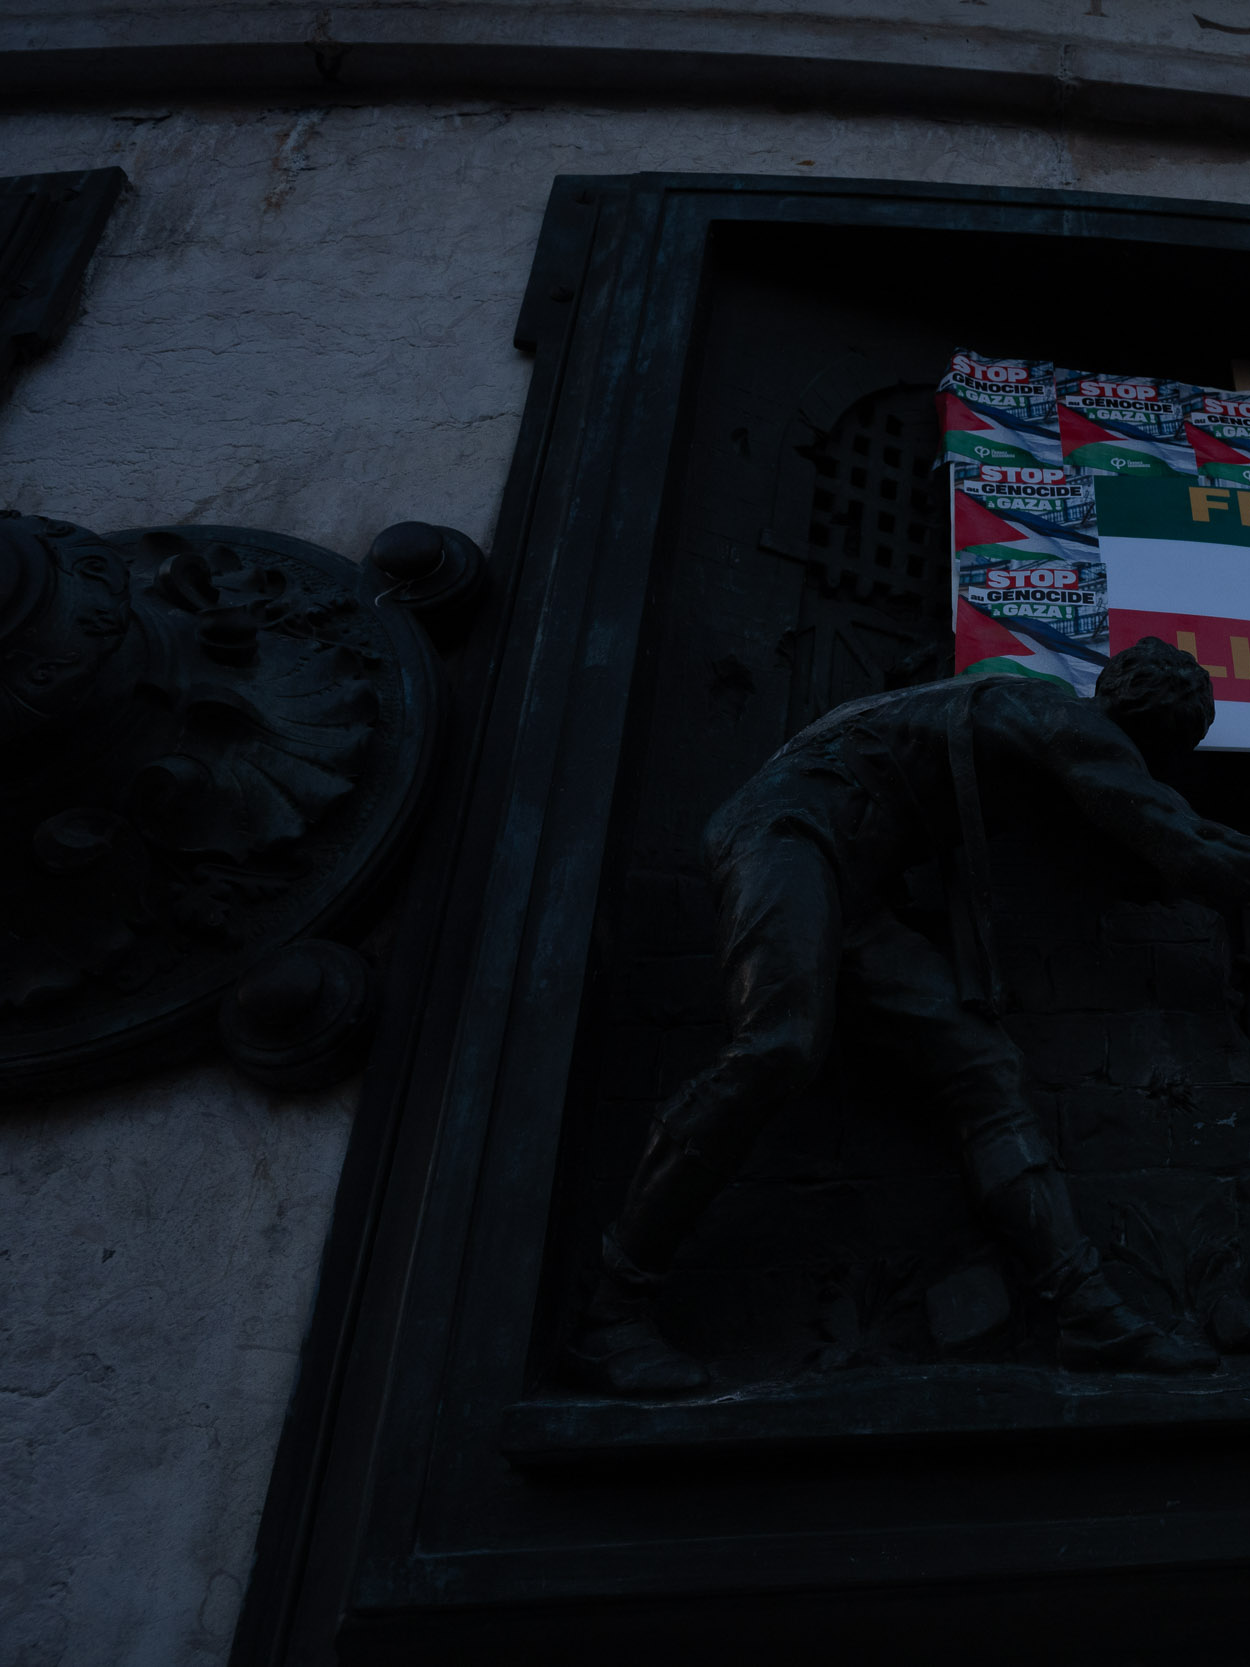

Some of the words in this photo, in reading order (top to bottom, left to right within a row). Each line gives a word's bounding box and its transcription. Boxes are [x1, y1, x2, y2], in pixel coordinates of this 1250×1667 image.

[953, 355, 1028, 383] STOP
[1080, 381, 1156, 400] STOP
[981, 465, 1064, 484] STOP
[987, 570, 1077, 588] STOP
